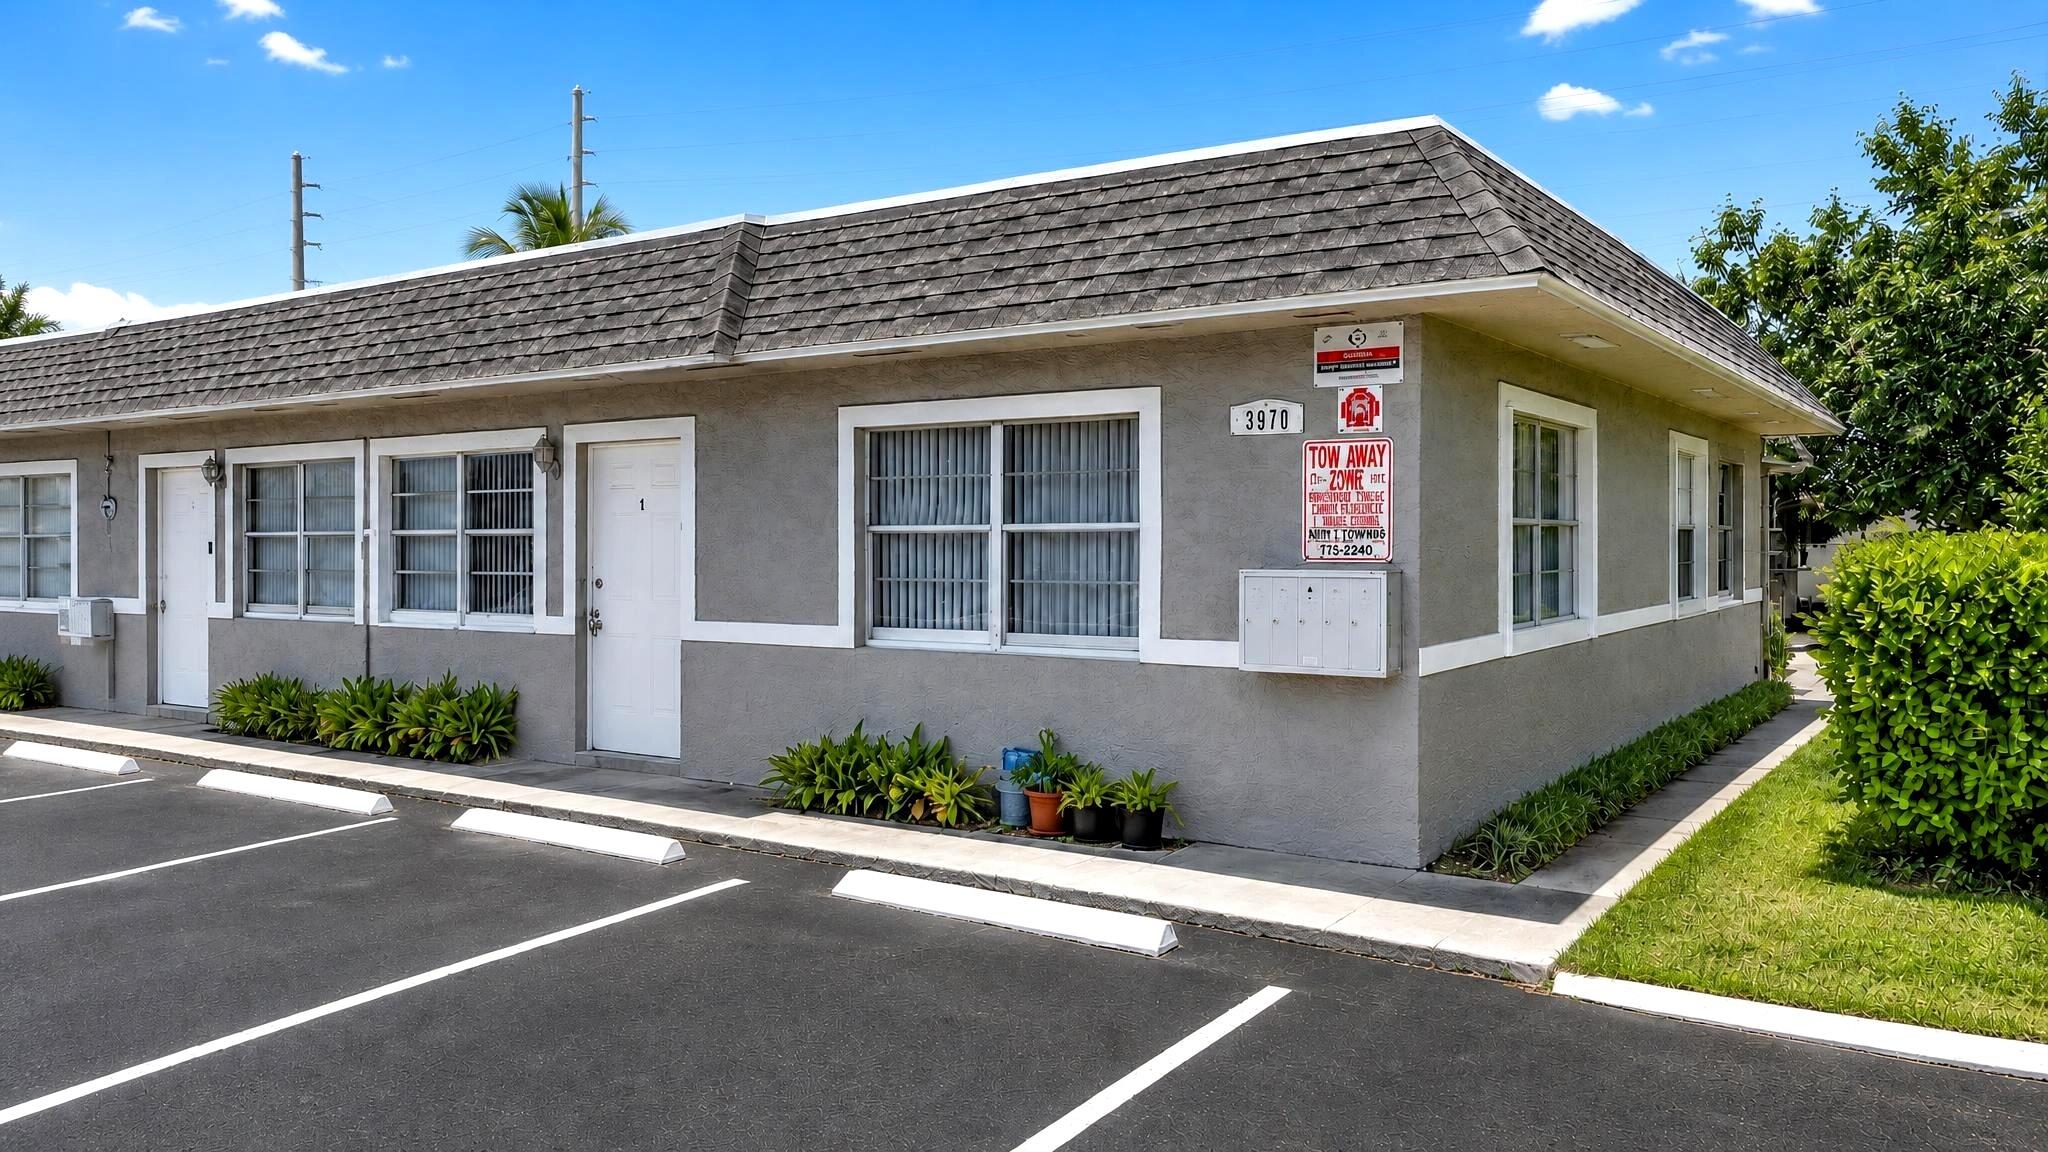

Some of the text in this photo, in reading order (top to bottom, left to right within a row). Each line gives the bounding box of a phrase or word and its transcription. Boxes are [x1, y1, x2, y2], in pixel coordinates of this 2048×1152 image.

[1245, 408, 1288, 431] 3970
[1308, 443, 1387, 469] TOW AWAY
[639, 497, 645, 511] 1
